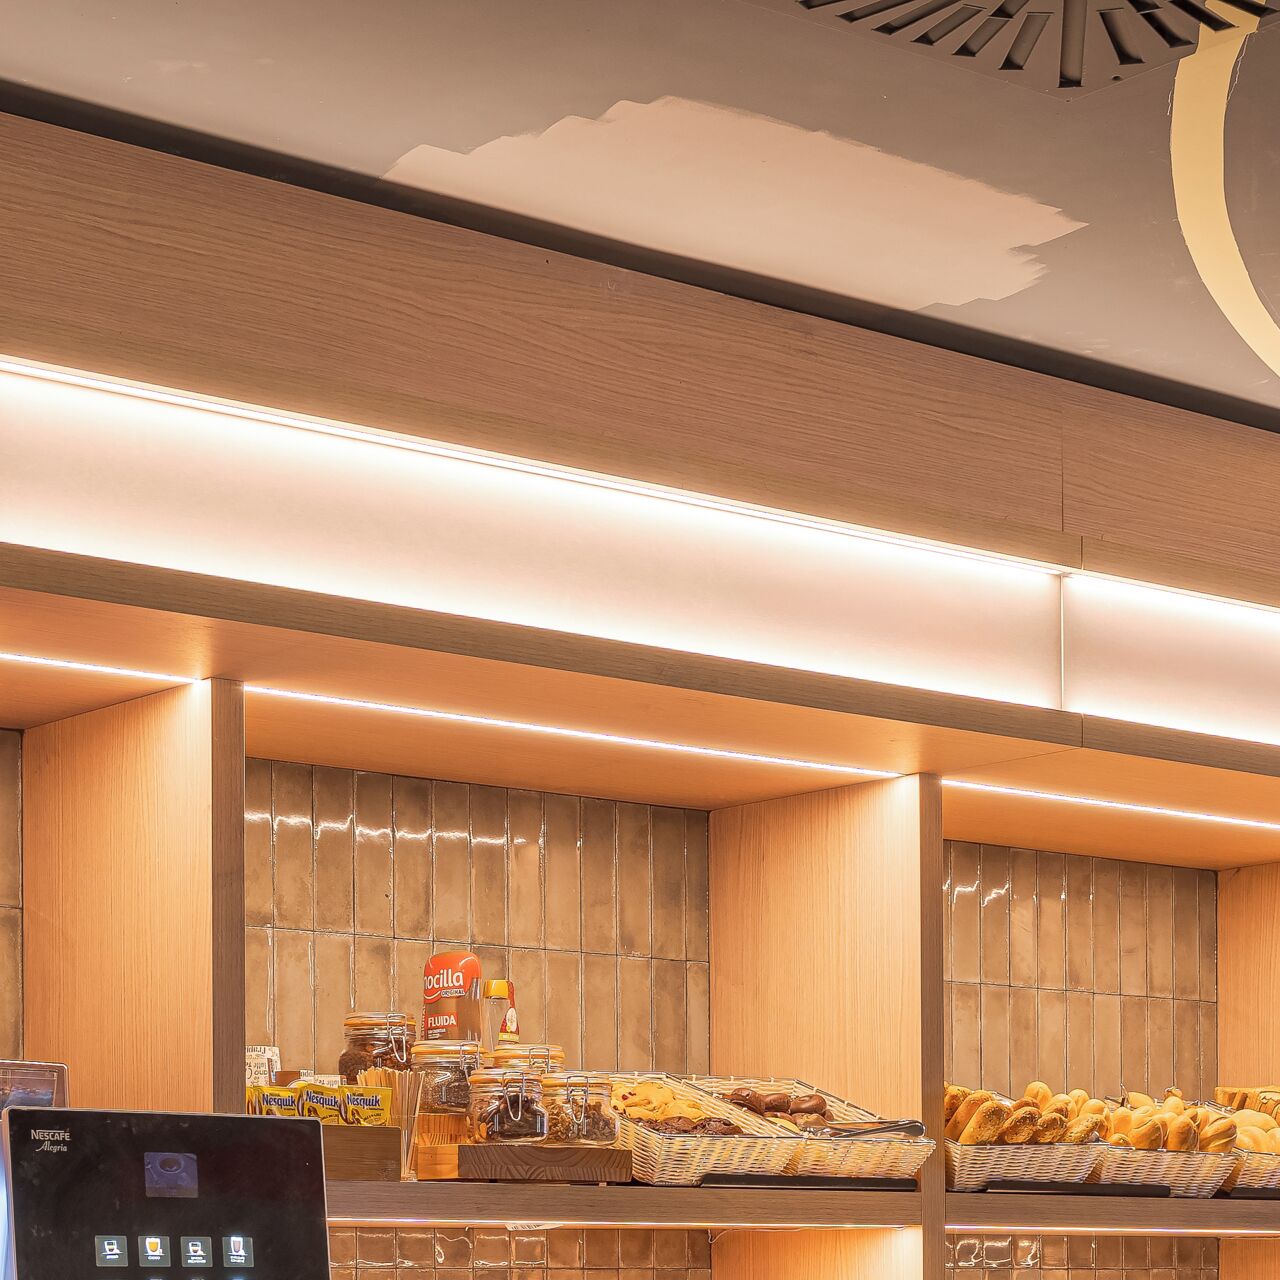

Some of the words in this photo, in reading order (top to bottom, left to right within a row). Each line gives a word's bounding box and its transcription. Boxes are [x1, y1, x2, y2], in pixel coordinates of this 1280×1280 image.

[441, 988, 464, 996] ORIGINAL
[428, 1014, 457, 1028] FLUIDA
[262, 1093, 296, 1108] Nesquik
[306, 1090, 340, 1108] Nesquik
[347, 1092, 380, 1109] Nesquik
[31, 1128, 71, 1140] NESCAFÉ
[35, 1141, 68, 1152] Alegria
